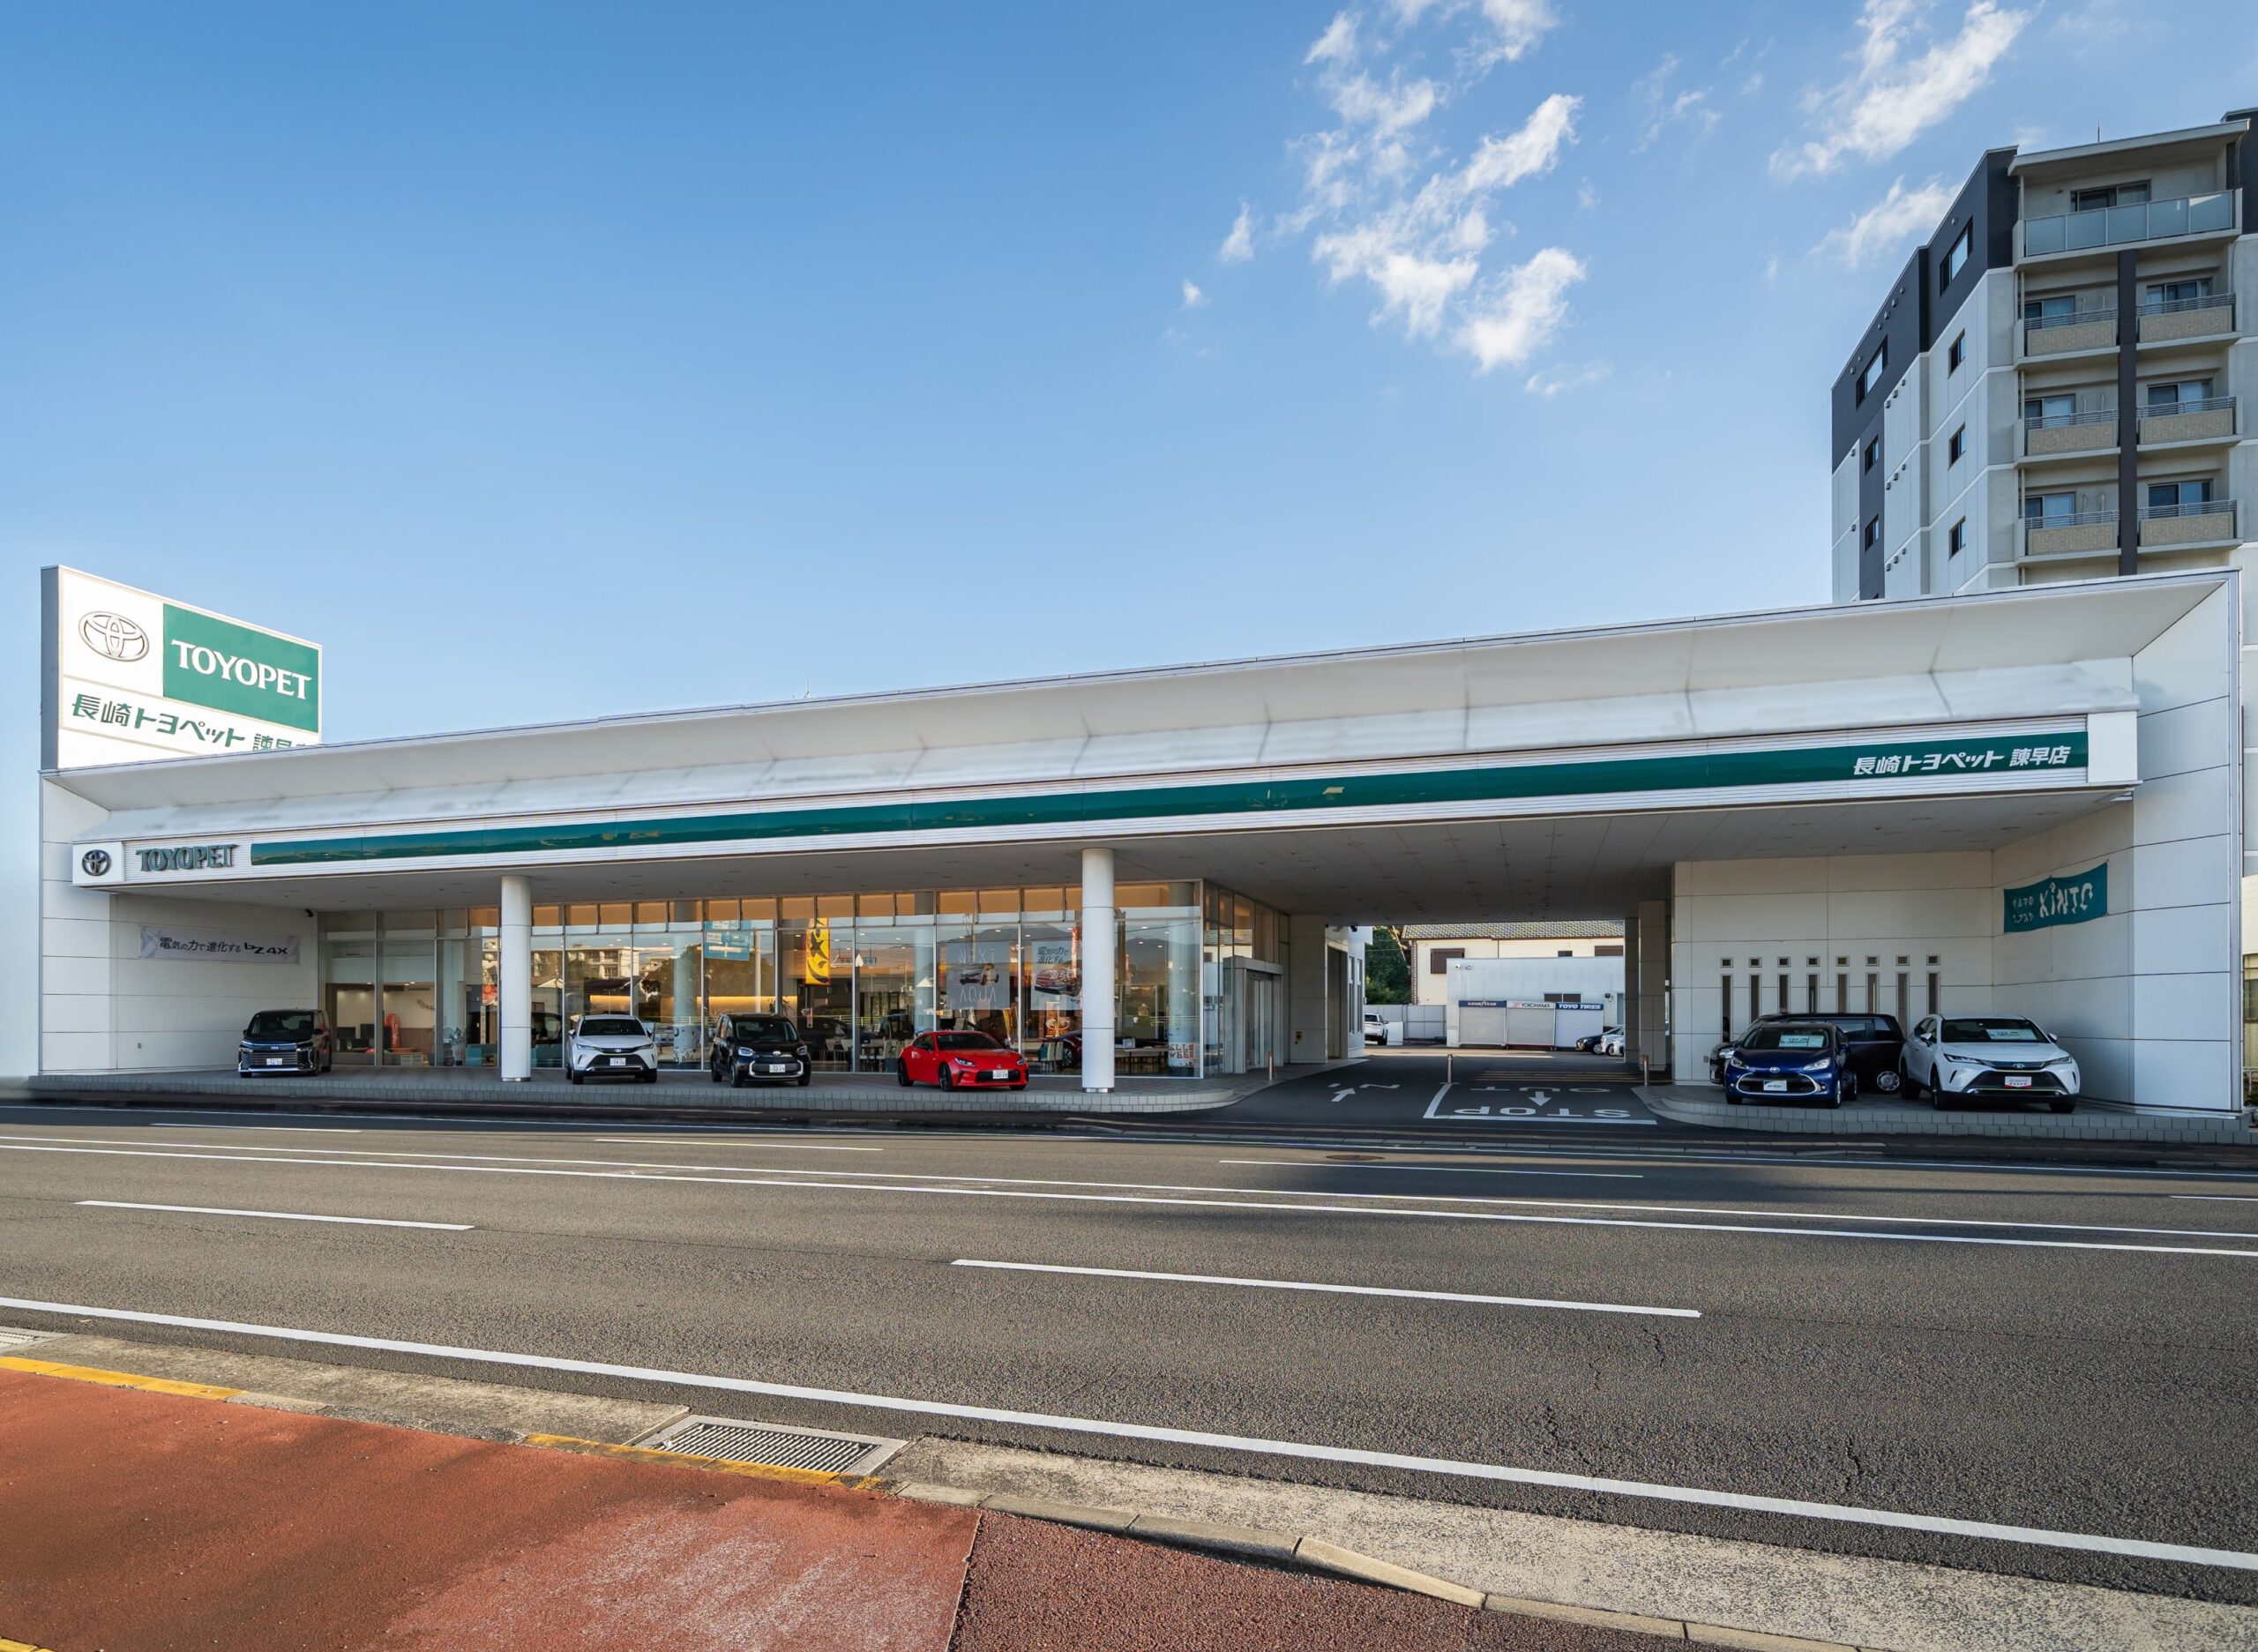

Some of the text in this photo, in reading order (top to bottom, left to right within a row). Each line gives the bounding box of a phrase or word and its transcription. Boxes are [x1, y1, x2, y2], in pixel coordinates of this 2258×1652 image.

[171, 639, 312, 699] TOYOPET
[71, 693, 245, 748] 長崎トヨペット
[1853, 745, 2071, 775] 長崎トヨペット 諫早店
[136, 844, 239, 871] TOYOPET
[160, 937, 242, 953] 電気の力で進化する
[959, 948, 996, 964] NXT
[959, 987, 997, 1004] AQUA
[1454, 1106, 1631, 1118] STOP
